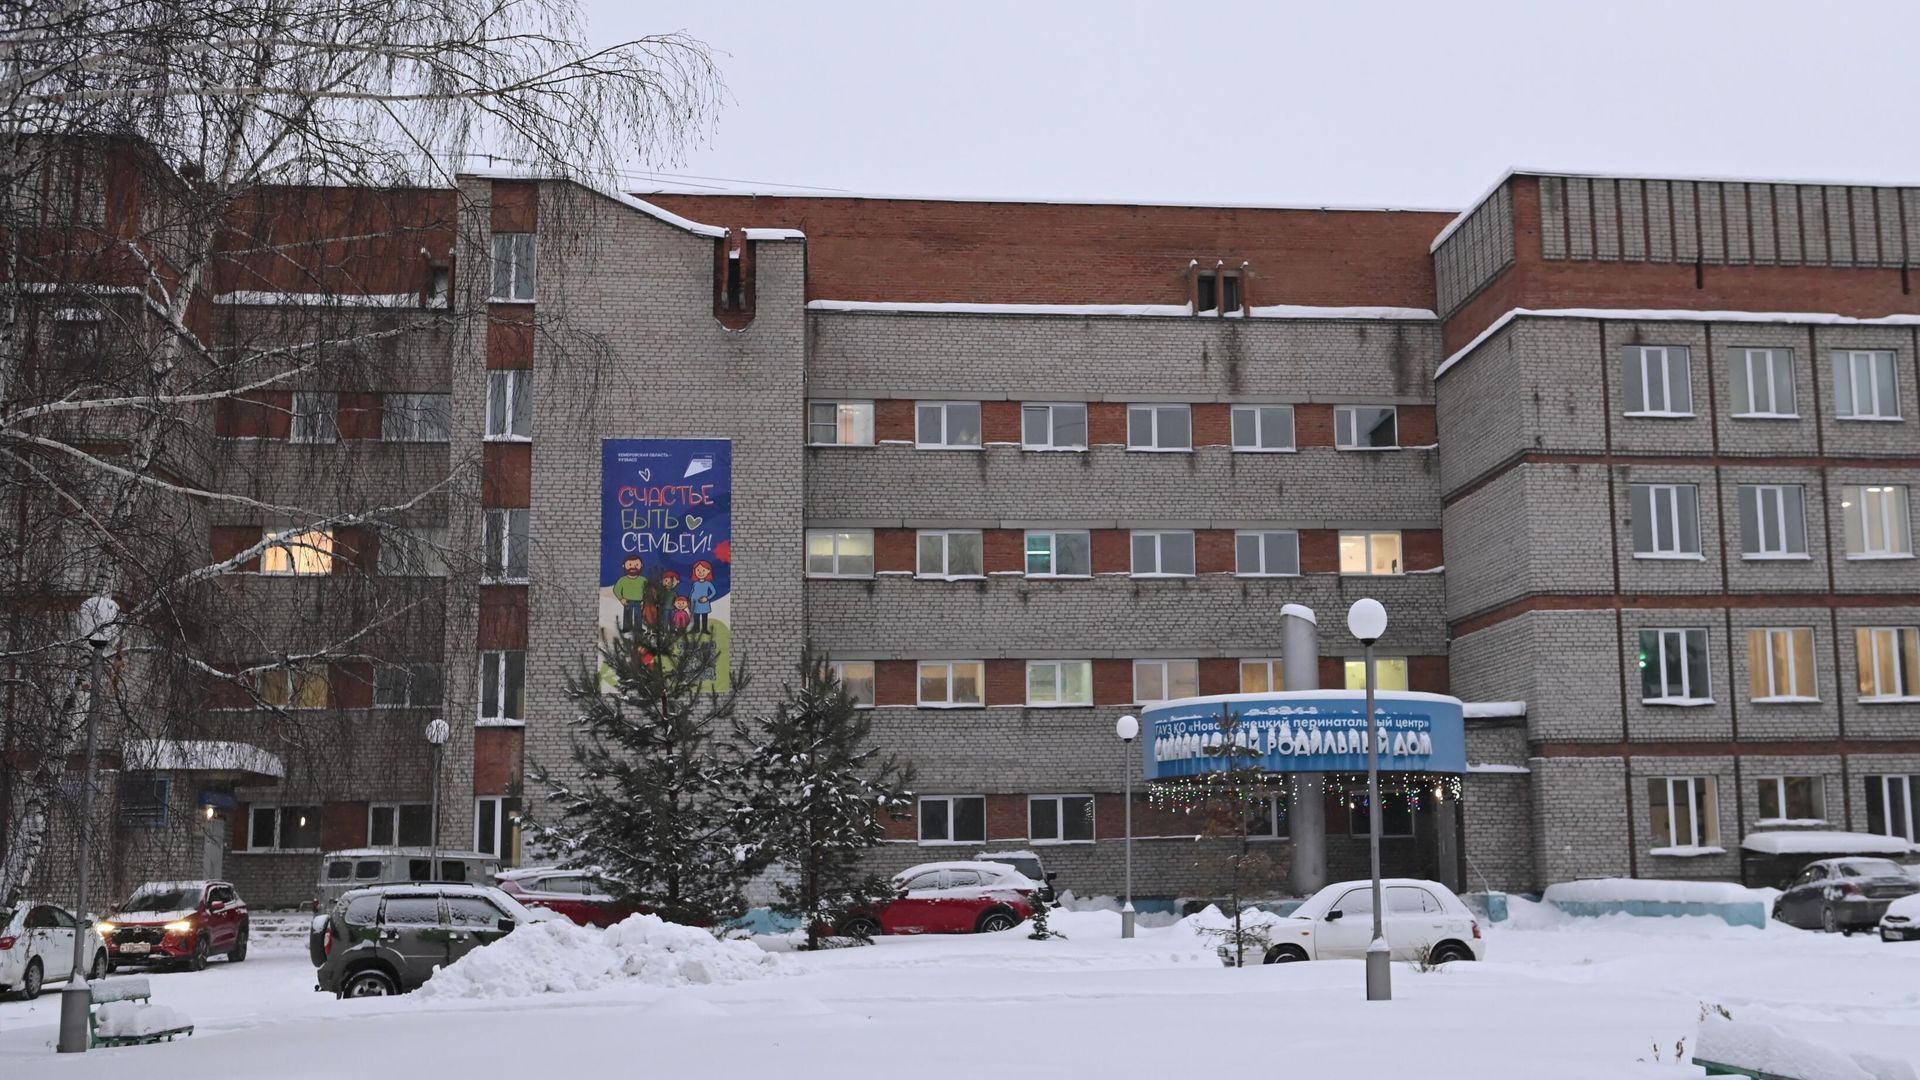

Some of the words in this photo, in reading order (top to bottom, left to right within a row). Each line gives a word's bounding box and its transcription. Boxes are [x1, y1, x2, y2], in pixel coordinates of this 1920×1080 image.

[618, 484, 714, 507] СЧАСТЬЕ
[621, 508, 679, 529] БЫТЬ
[1155, 723, 1172, 736] ГАУЗ
[1173, 722, 1186, 734] КО
[1293, 716, 1392, 731] перинатальый
[1395, 718, 1429, 731] центр»
[1393, 731, 1433, 756] ДОМ
